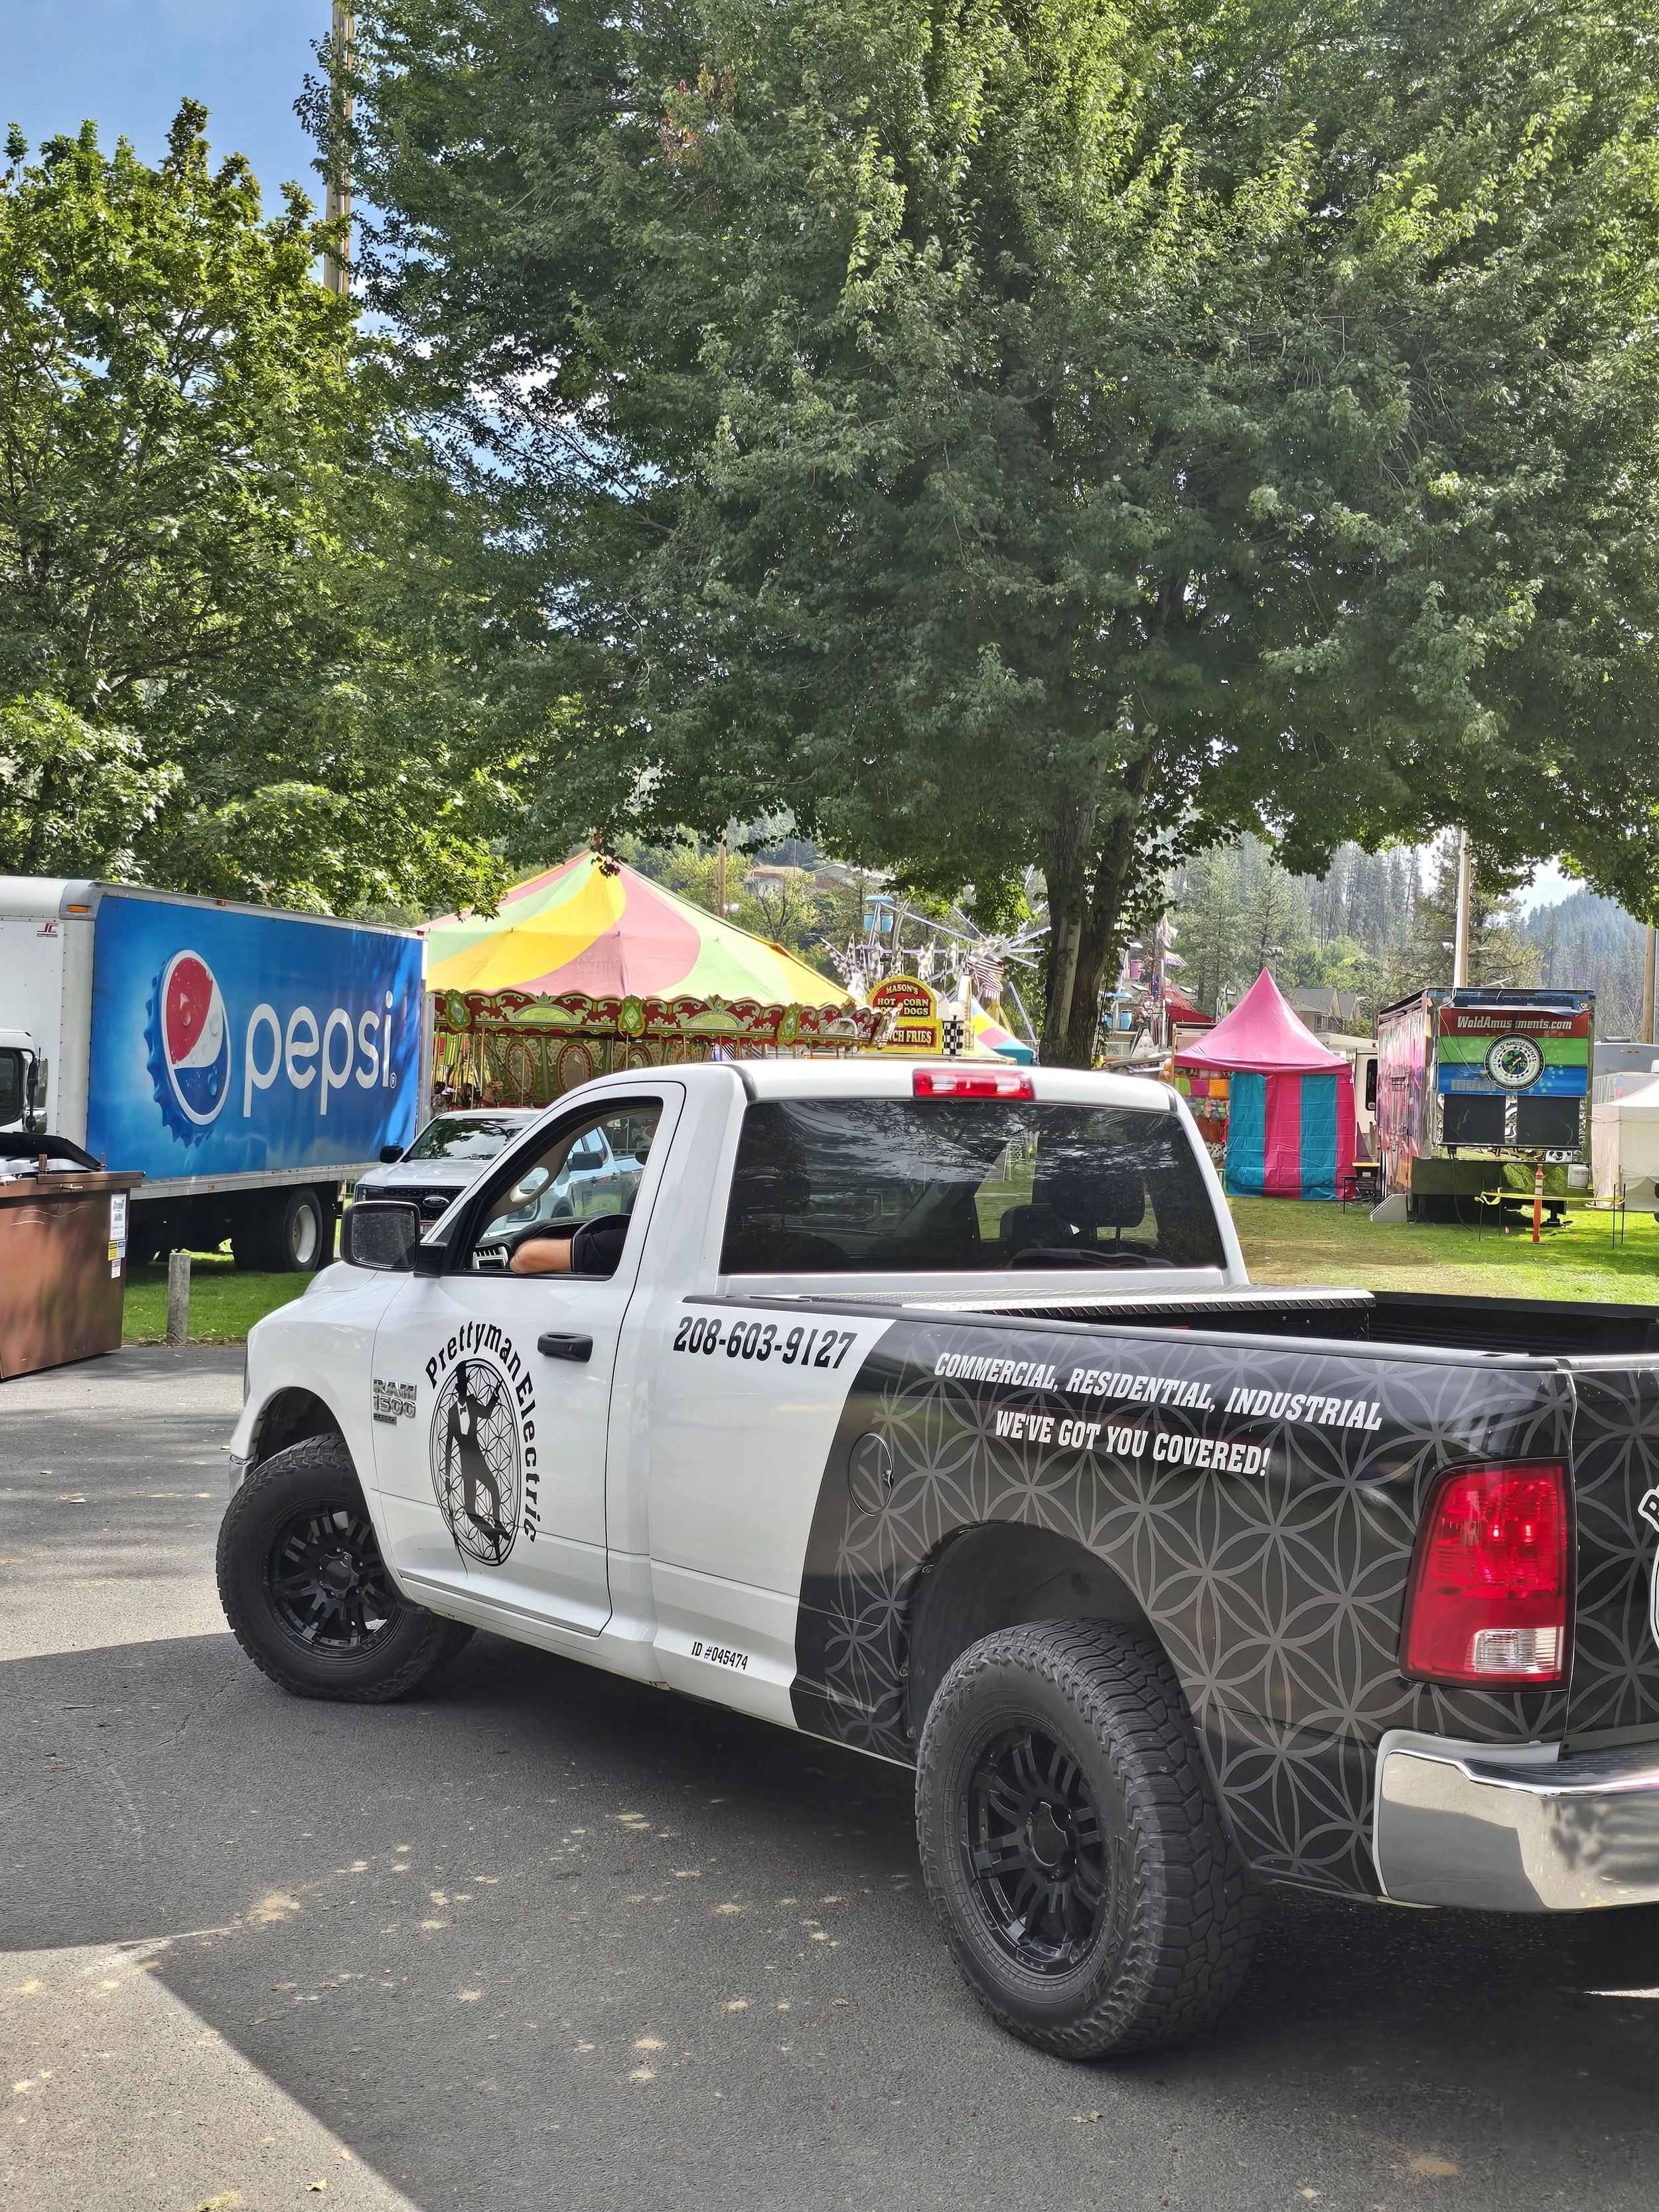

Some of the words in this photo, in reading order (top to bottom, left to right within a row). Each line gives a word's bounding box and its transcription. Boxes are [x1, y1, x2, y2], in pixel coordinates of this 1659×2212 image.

[886, 984, 919, 995] MASON'S
[1457, 1016, 1572, 1029] WoldAmusments.com
[906, 1030, 932, 1045] FRIES
[243, 990, 393, 1118] pepsi
[673, 1316, 858, 1369] 208-603-9127
[373, 1378, 417, 1401] RAM
[934, 1353, 1058, 1392] COMMERCIAL,
[1065, 1368, 1216, 1413] RESIDENTIAL,
[1224, 1387, 1383, 1431] INDUSTRIAL
[373, 1394, 416, 1418] 1500
[995, 1410, 1055, 1443] WE'VE
[1058, 1419, 1102, 1450] GOT
[1106, 1426, 1149, 1458] YOU
[1153, 1432, 1271, 1477] COVERED!
[691, 1641, 703, 1657] ID
[703, 1646, 748, 1670] #045474
